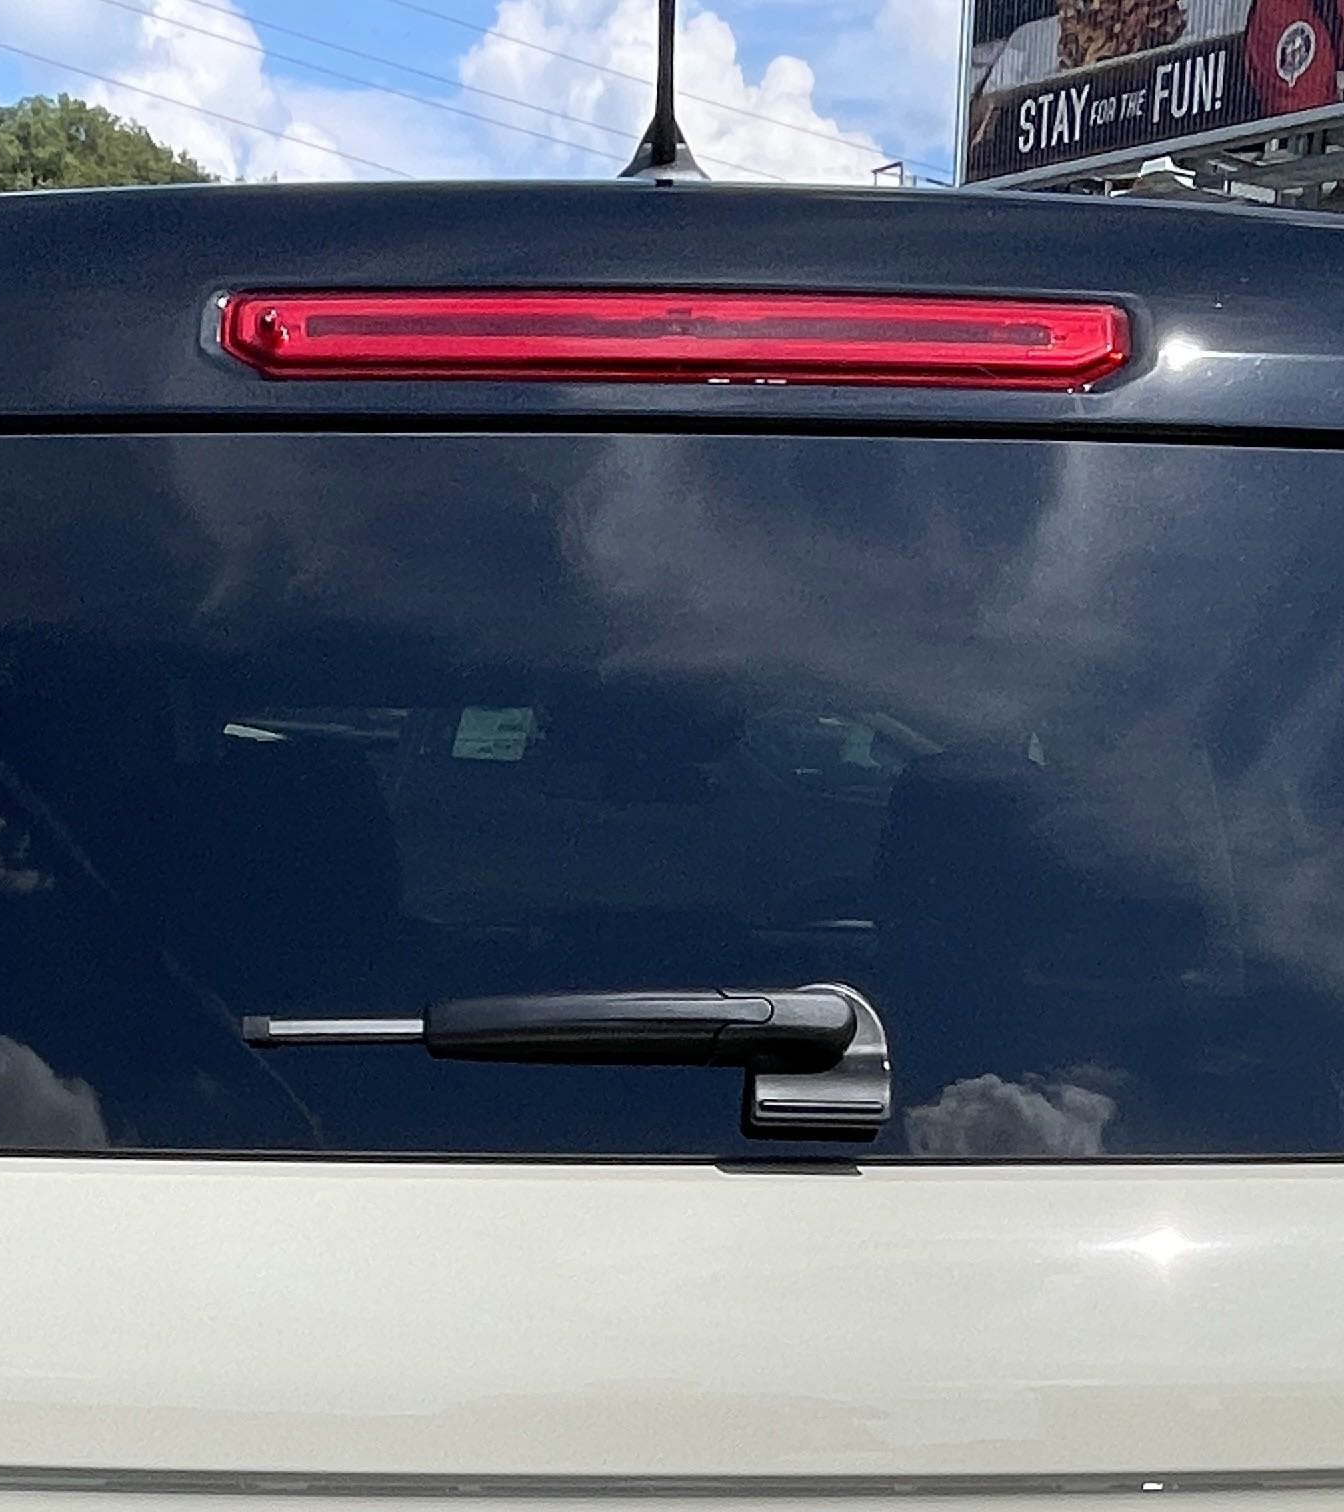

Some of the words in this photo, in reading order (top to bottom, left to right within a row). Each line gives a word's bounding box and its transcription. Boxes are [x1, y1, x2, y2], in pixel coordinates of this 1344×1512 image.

[1019, 84, 1091, 154] STAY
[1090, 100, 1115, 127] FOR
[1118, 89, 1148, 122] THE
[1152, 50, 1226, 124] FUN!
